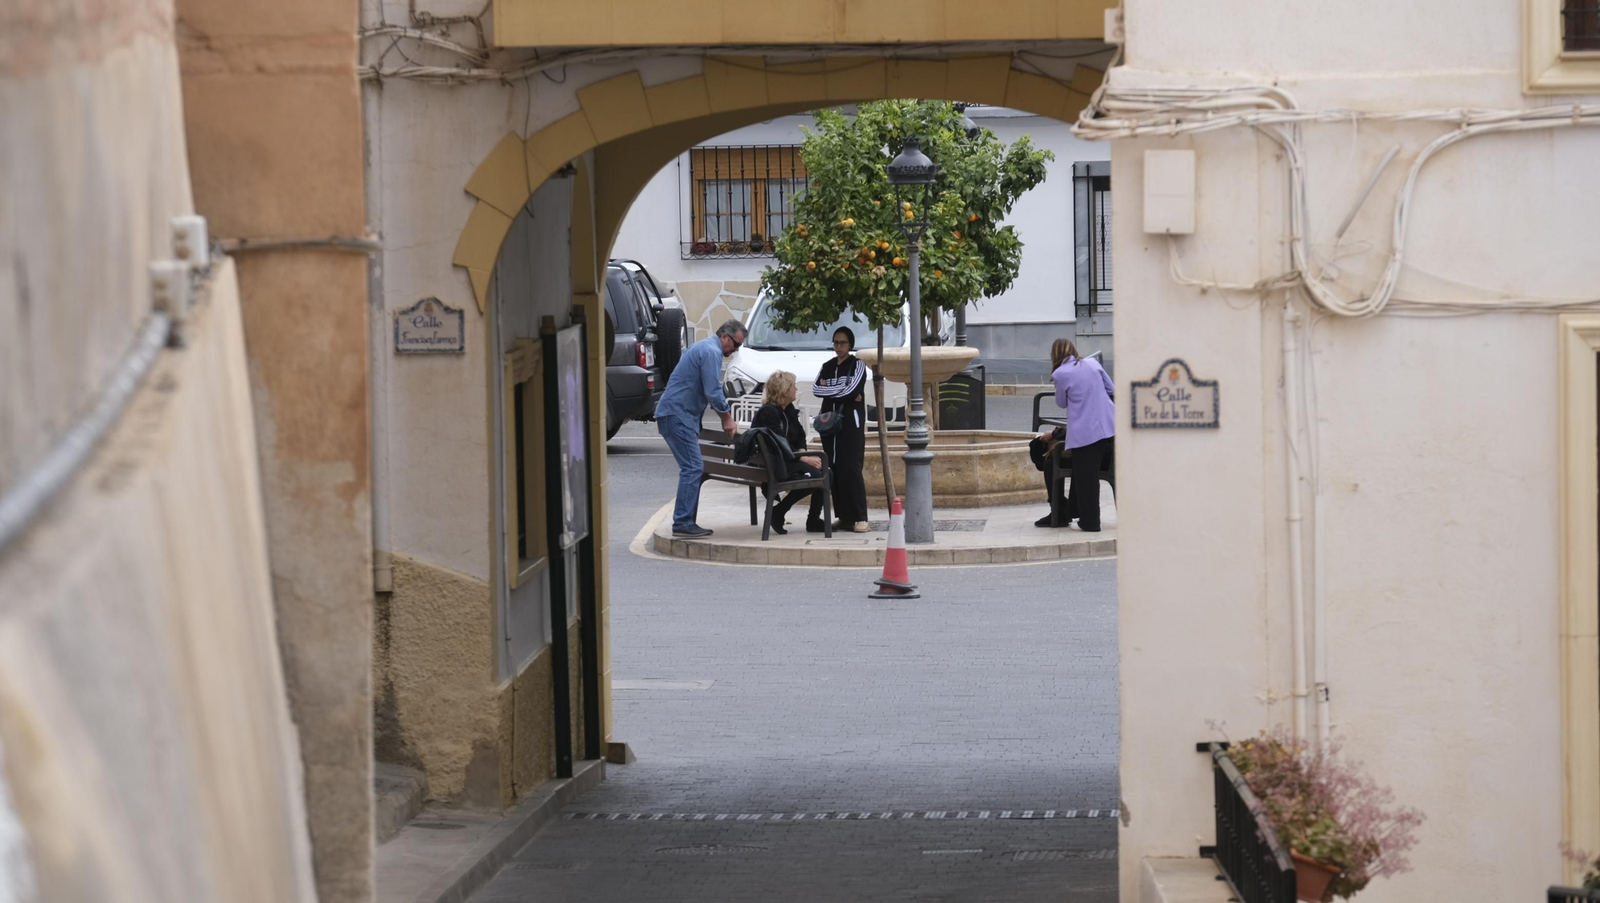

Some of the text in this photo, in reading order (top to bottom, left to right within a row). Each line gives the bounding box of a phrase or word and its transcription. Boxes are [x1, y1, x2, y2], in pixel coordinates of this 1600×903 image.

[409, 316, 443, 328] Calle
[1153, 387, 1191, 402] Calle
[1144, 403, 1205, 419] Pie de la Torre
